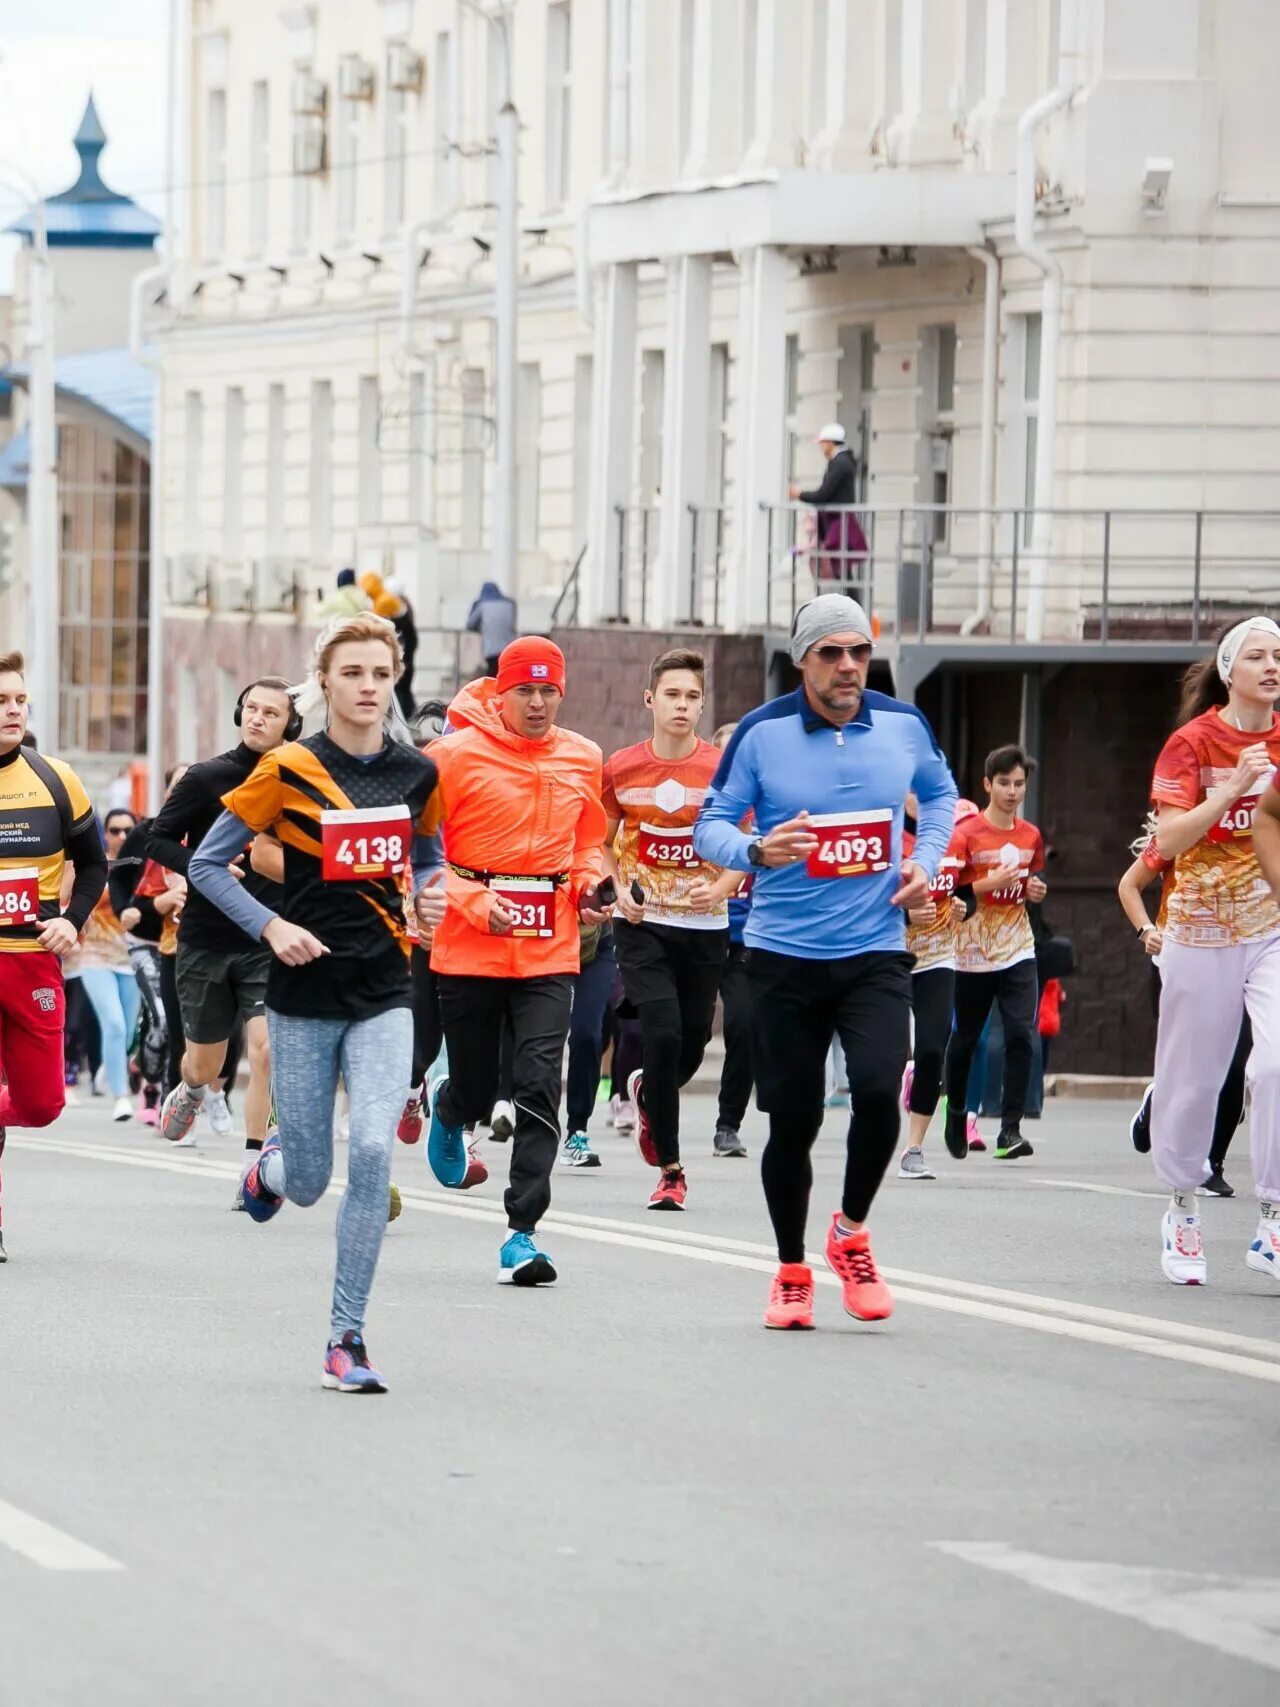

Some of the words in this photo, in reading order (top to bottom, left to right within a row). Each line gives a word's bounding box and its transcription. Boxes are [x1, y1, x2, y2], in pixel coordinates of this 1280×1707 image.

[336, 835, 402, 864] 4138
[646, 843, 694, 860] 4320
[818, 836, 883, 864] 4093
[928, 873, 954, 891] 023
[509, 904, 546, 926] 531
